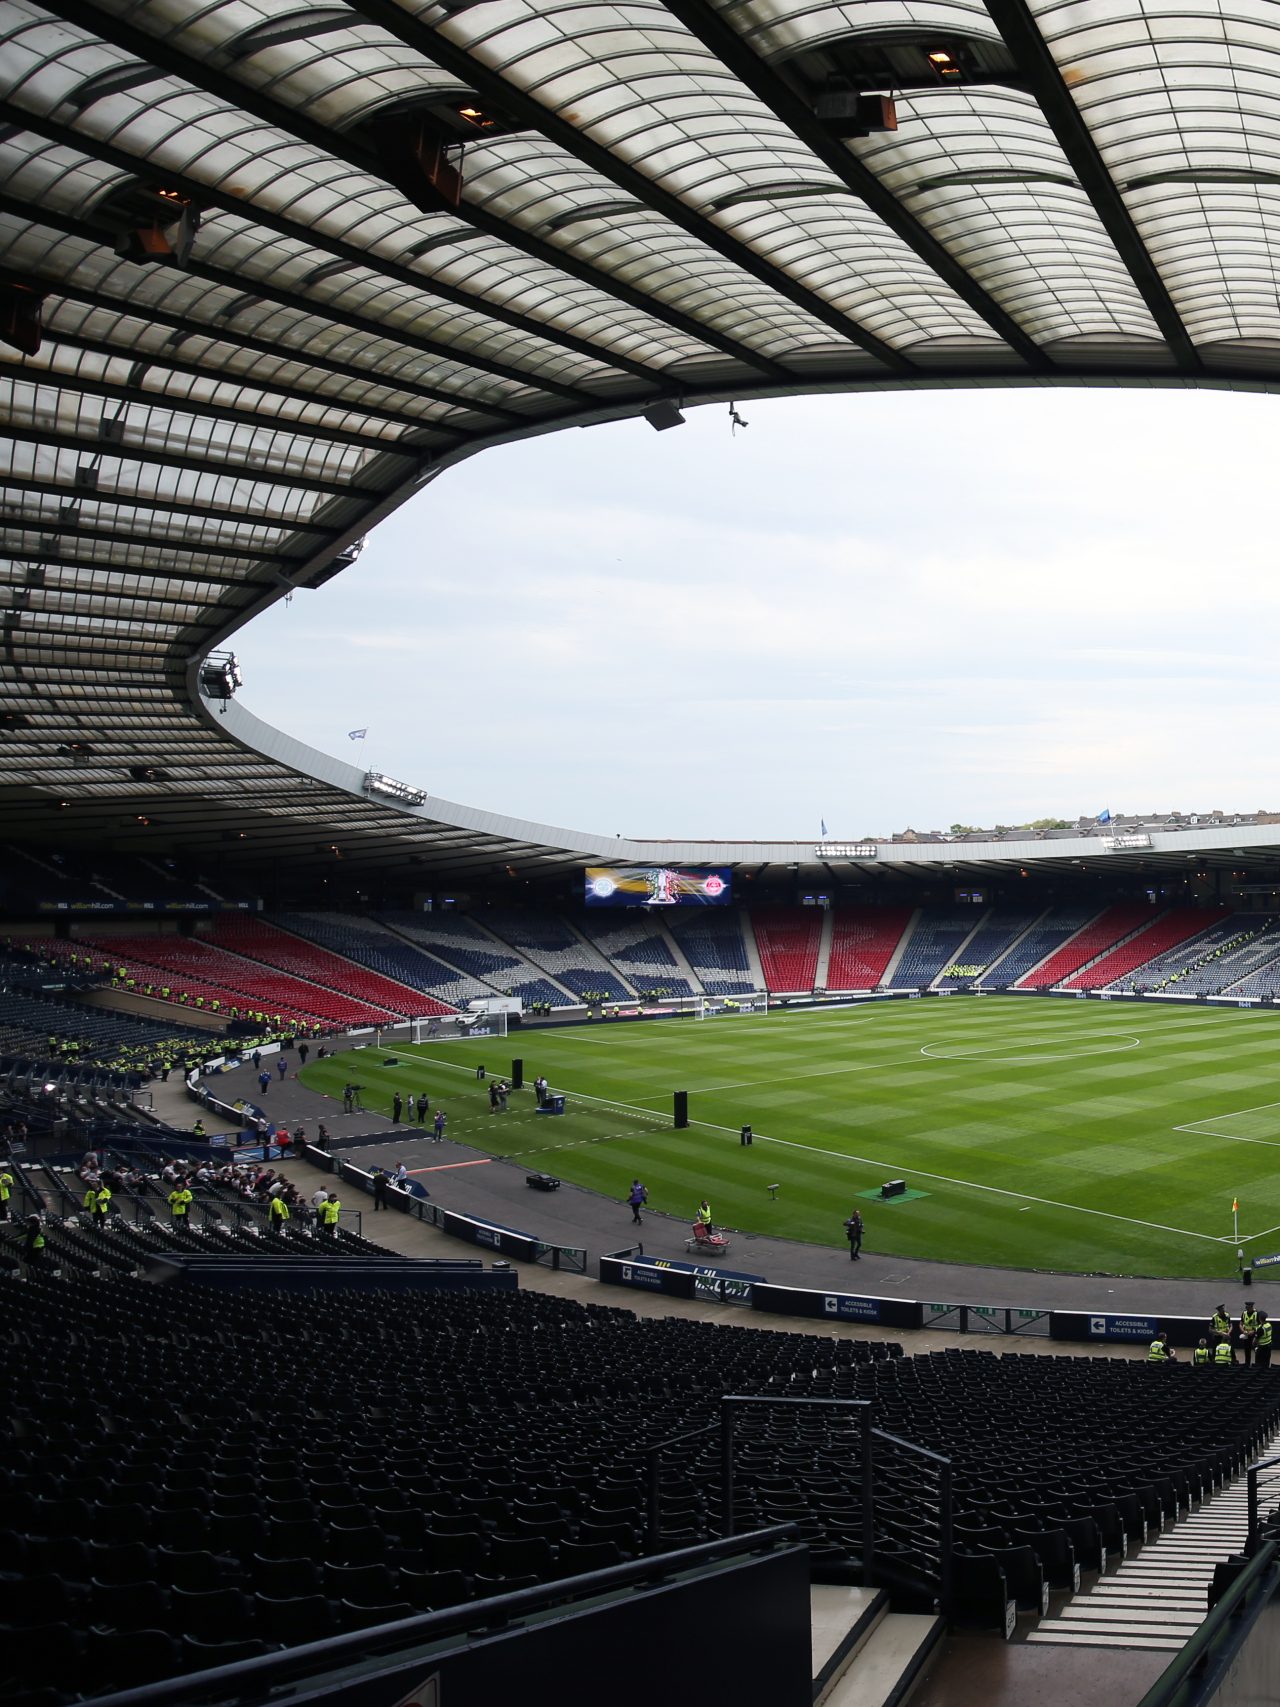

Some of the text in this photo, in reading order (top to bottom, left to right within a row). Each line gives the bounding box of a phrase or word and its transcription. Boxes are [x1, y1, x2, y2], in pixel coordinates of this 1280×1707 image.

[845, 1300, 873, 1309] ACCESSIBLE
[1115, 1319, 1148, 1328] ACCESSIBLE
[1109, 1327, 1132, 1335] TOILETS
